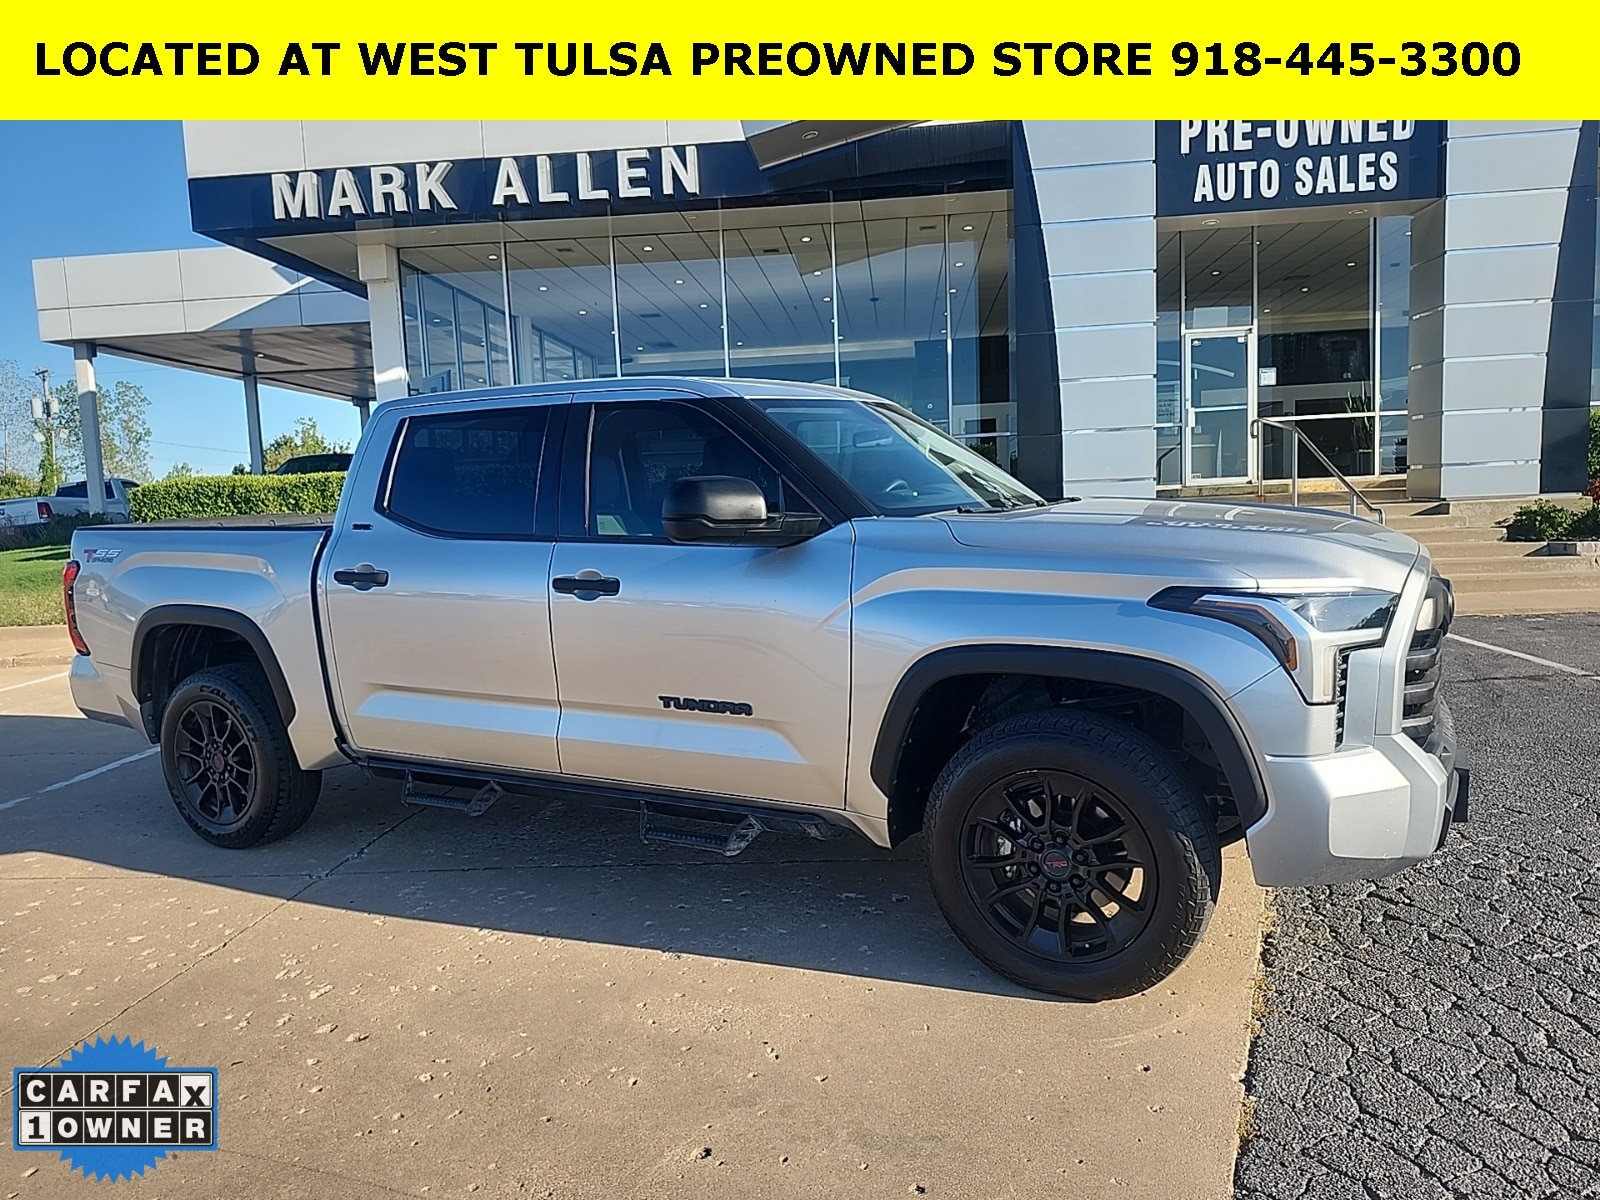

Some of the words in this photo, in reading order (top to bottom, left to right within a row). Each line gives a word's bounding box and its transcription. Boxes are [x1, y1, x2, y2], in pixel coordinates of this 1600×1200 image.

[271, 161, 459, 220] MARK
[493, 145, 701, 206] ALLEN
[1193, 159, 1280, 203] AUTO
[1294, 151, 1398, 196] SALES
[658, 696, 753, 716] TUNDRA
